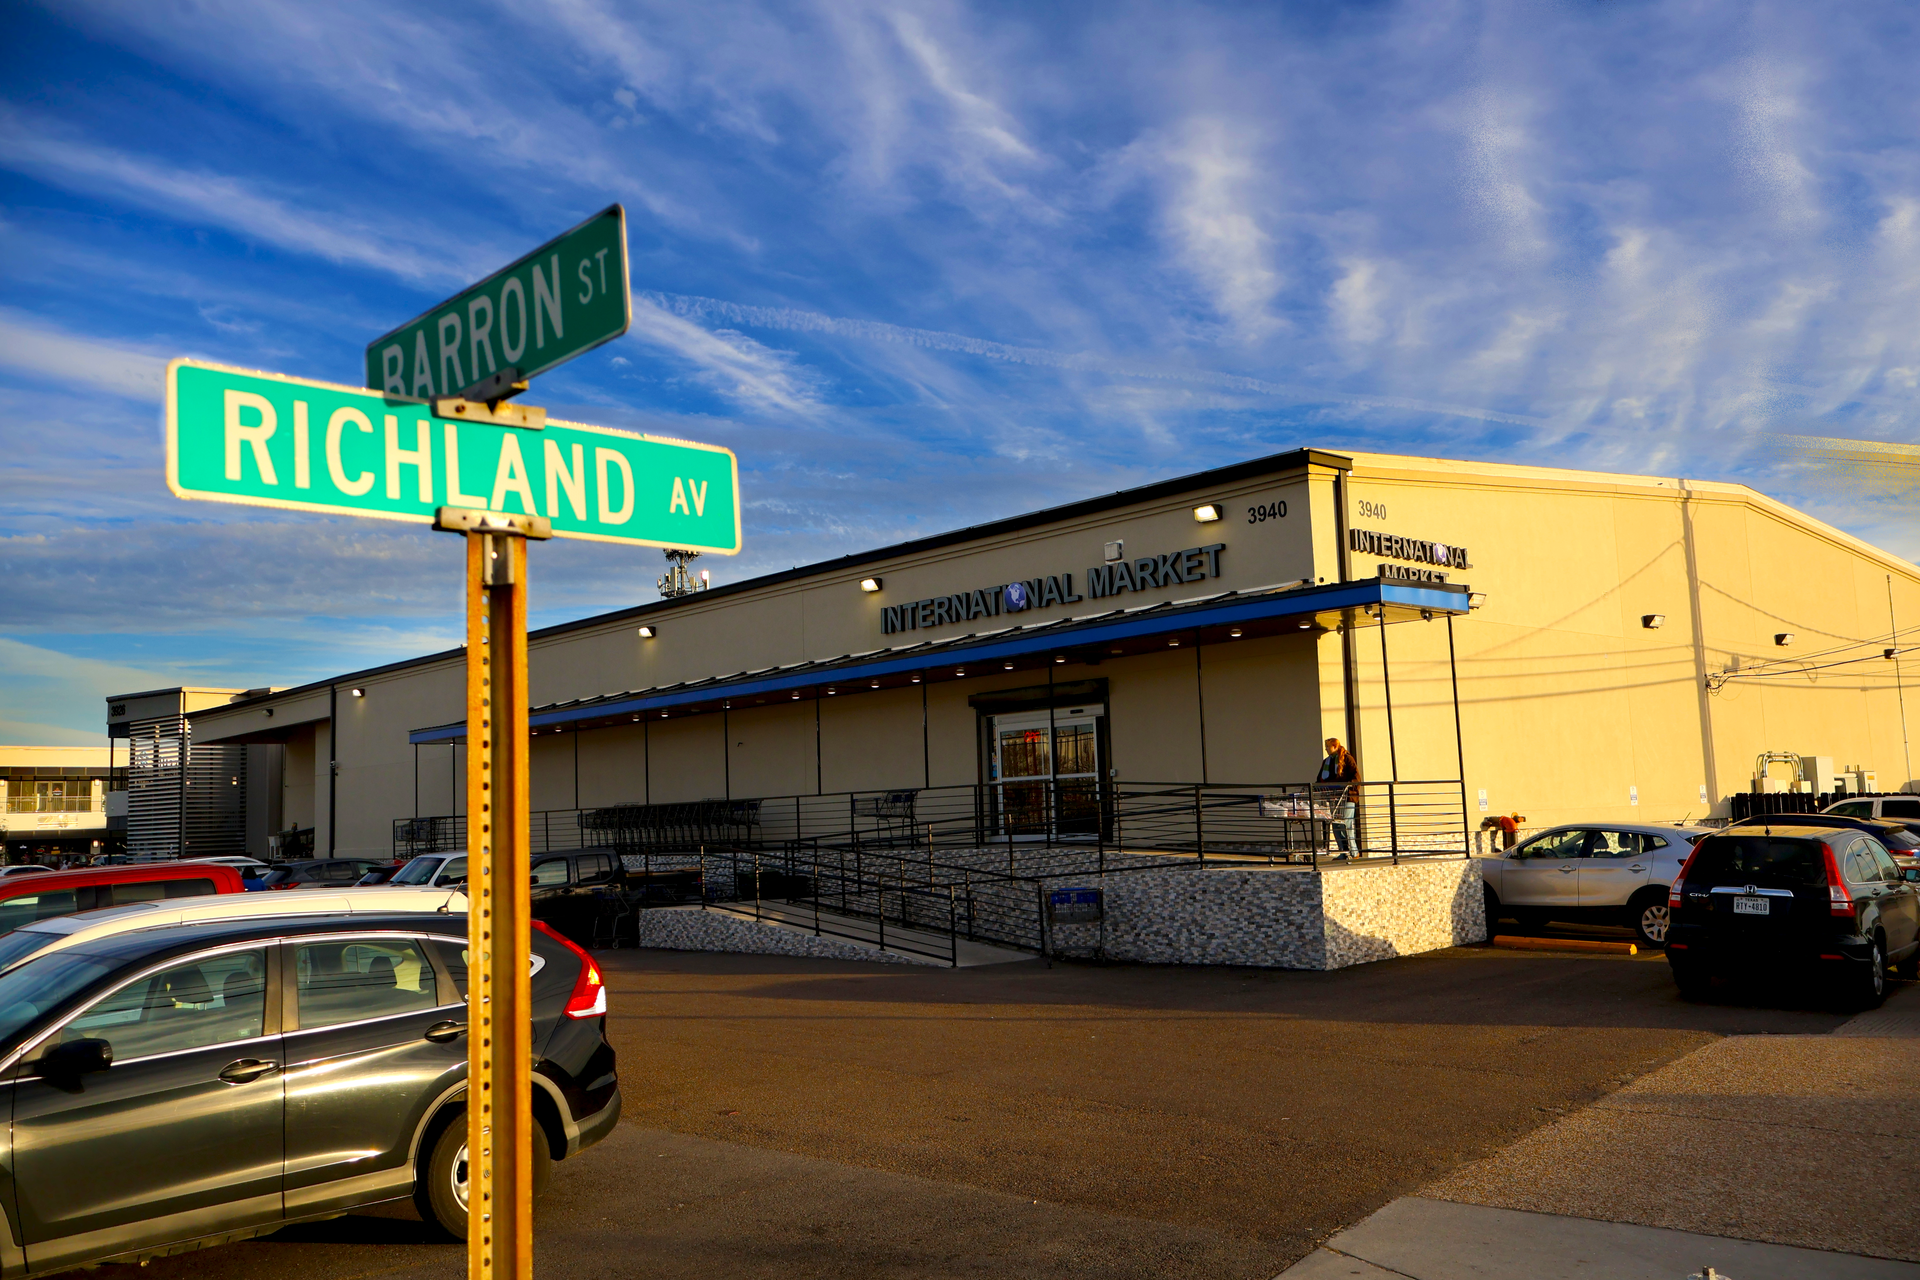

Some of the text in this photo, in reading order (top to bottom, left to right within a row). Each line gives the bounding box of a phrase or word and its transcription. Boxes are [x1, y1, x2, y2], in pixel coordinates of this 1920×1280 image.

[382, 248, 608, 398] BARRON ST
[223, 388, 708, 525] RICHLAND AV
[1247, 500, 1288, 524] 3940
[1358, 499, 1387, 520] 3940
[1087, 543, 1226, 598] MARKET
